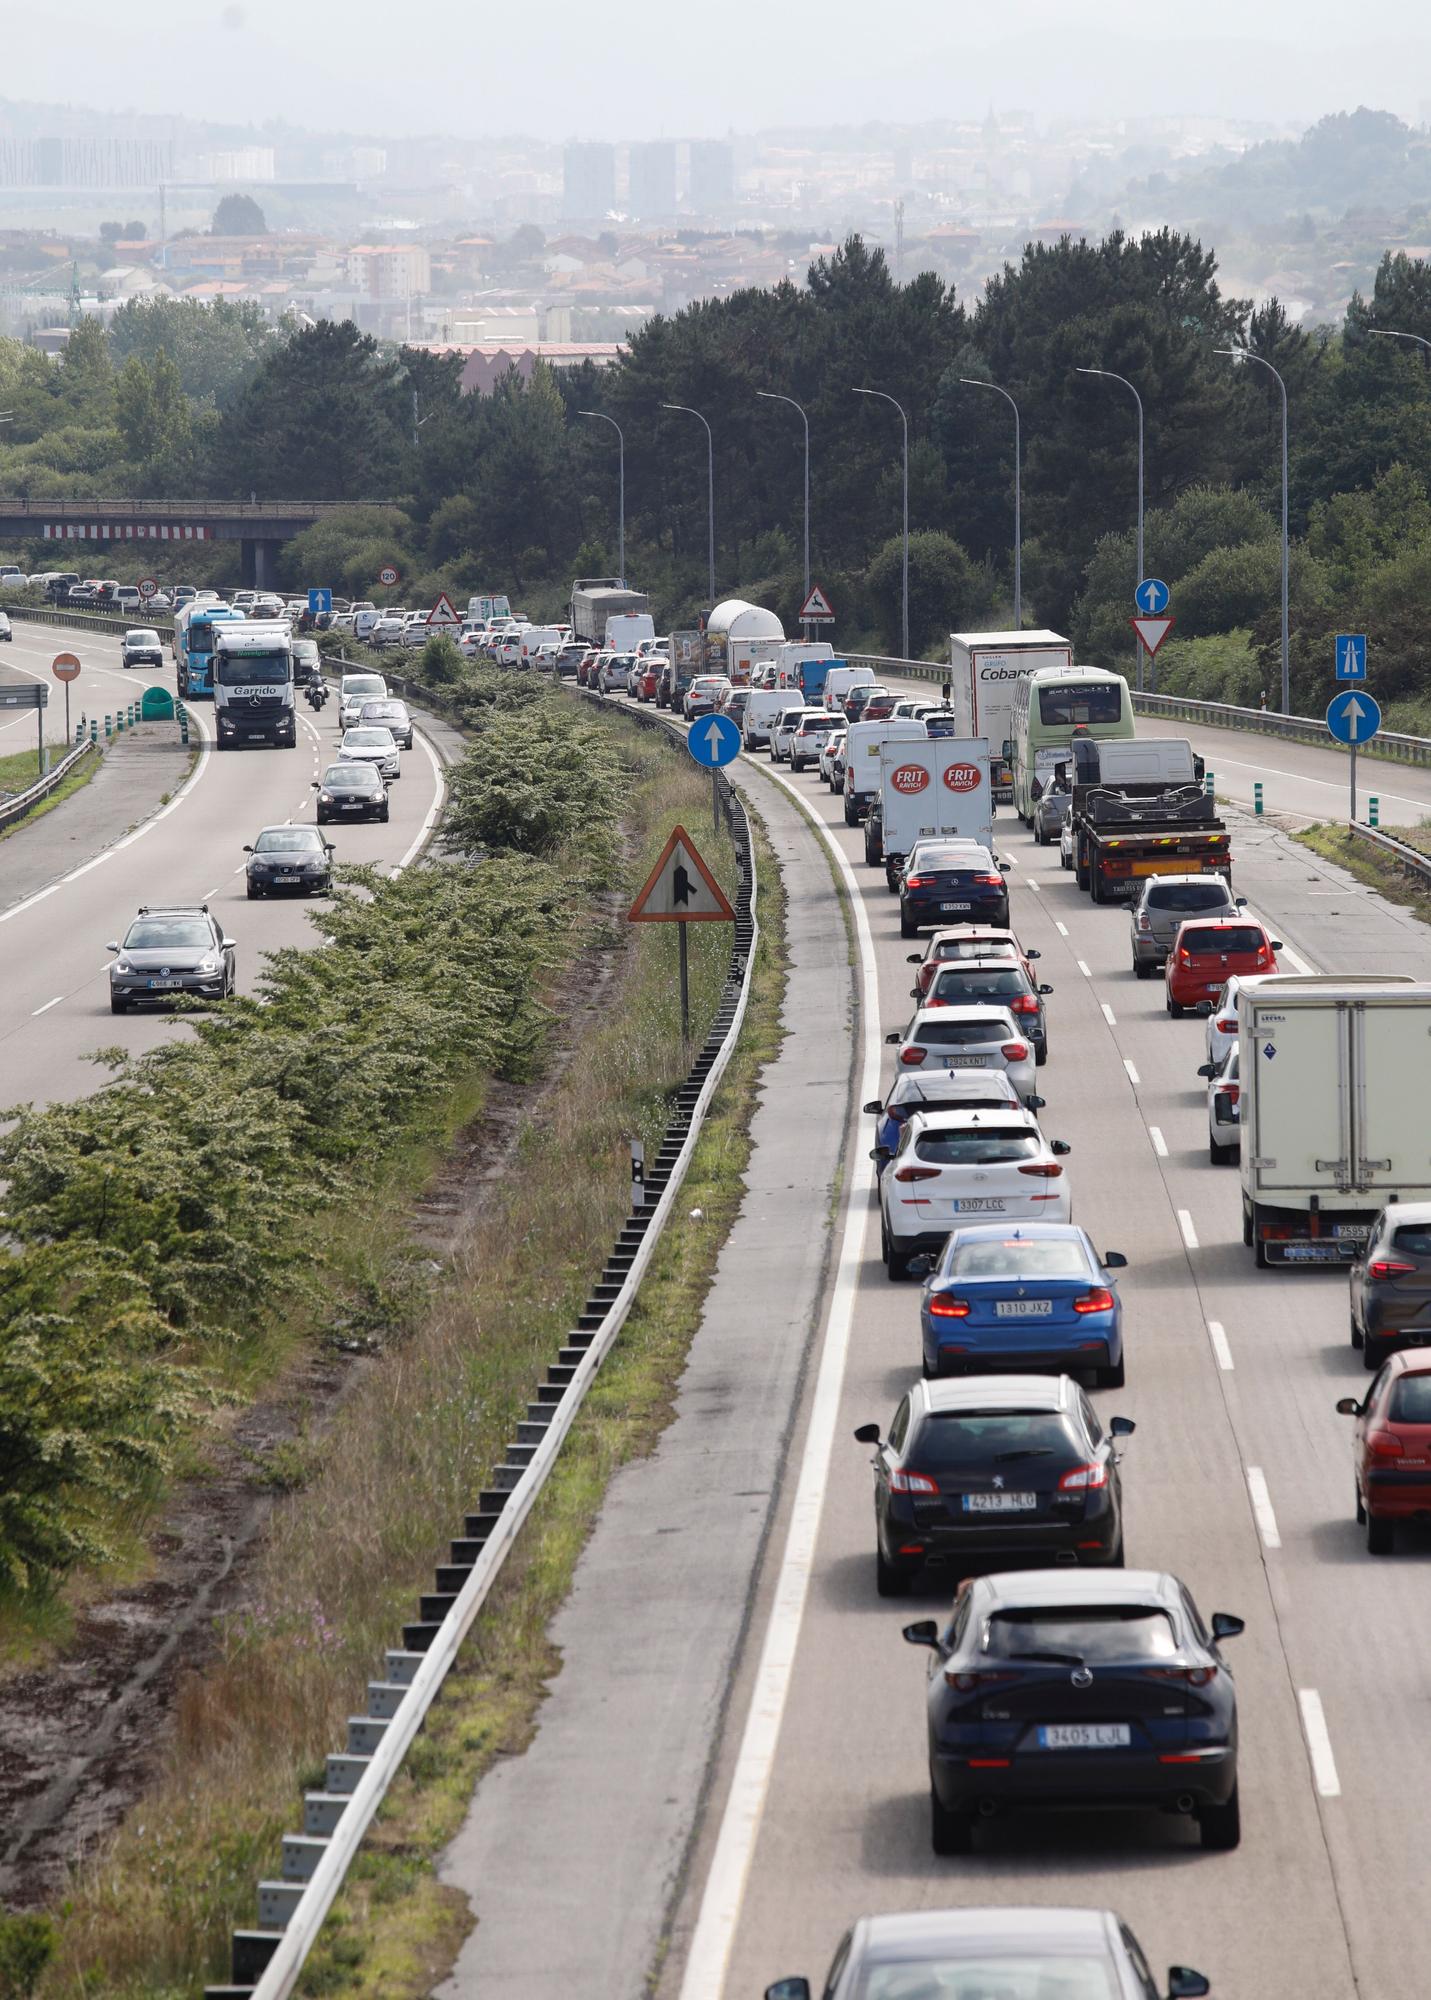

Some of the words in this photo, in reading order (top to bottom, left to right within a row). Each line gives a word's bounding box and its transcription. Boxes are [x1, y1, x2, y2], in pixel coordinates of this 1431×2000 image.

[142, 584, 155, 592] 120
[234, 686, 276, 695] Garrido
[896, 770, 925, 783] FRIT
[947, 769, 977, 781] FRIT
[960, 1200, 983, 1210] 3307
[986, 1199, 1004, 1209] LCC
[1340, 1226, 1365, 1236] 7595
[1001, 1303, 1026, 1314] 1310
[1030, 1302, 1050, 1313] JXZ
[973, 1493, 1002, 1508] 4213
[1051, 1728, 1090, 1745] 3405
[1094, 1726, 1126, 1743] LJL
